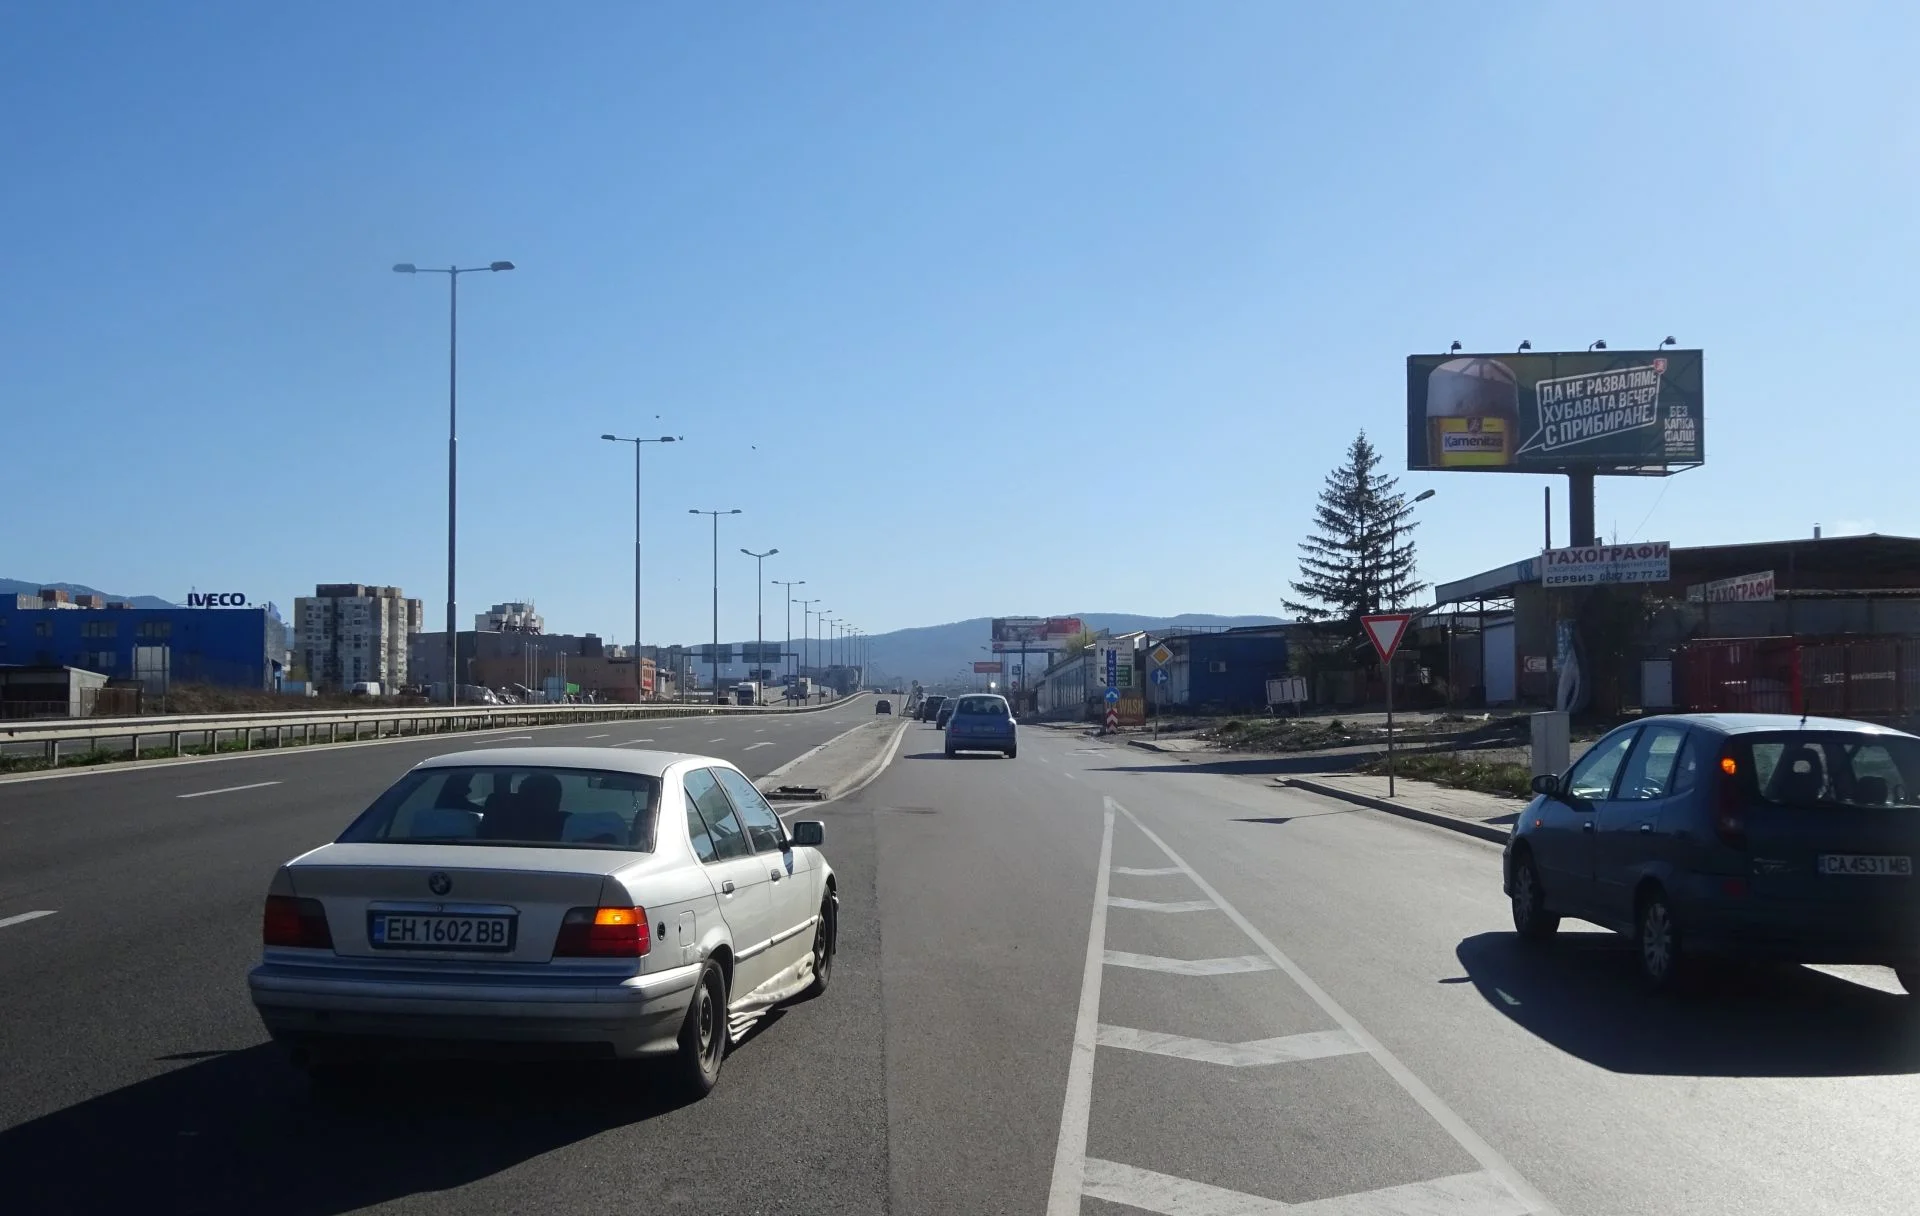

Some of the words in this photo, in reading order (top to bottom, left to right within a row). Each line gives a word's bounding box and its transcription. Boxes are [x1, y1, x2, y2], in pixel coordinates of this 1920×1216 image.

[1543, 385, 1563, 404] ДА
[1566, 381, 1585, 399] НЕ
[1587, 370, 1657, 395] РАЗВАЛЯМЕ
[1544, 397, 1616, 423] ХУБАВАТА
[1619, 388, 1656, 408] ВЕЧЕР
[1670, 405, 1688, 418] БЕЗ
[1444, 434, 1503, 448] Kamenitza
[1545, 425, 1558, 445] С
[1546, 544, 1668, 565] ТАХОГРАФИ
[1546, 574, 1594, 584] СЕРВИЗ
[1626, 571, 1638, 580] 27
[1641, 570, 1653, 579] 77
[1656, 569, 1668, 578] 22
[187, 592, 246, 607] IVECO
